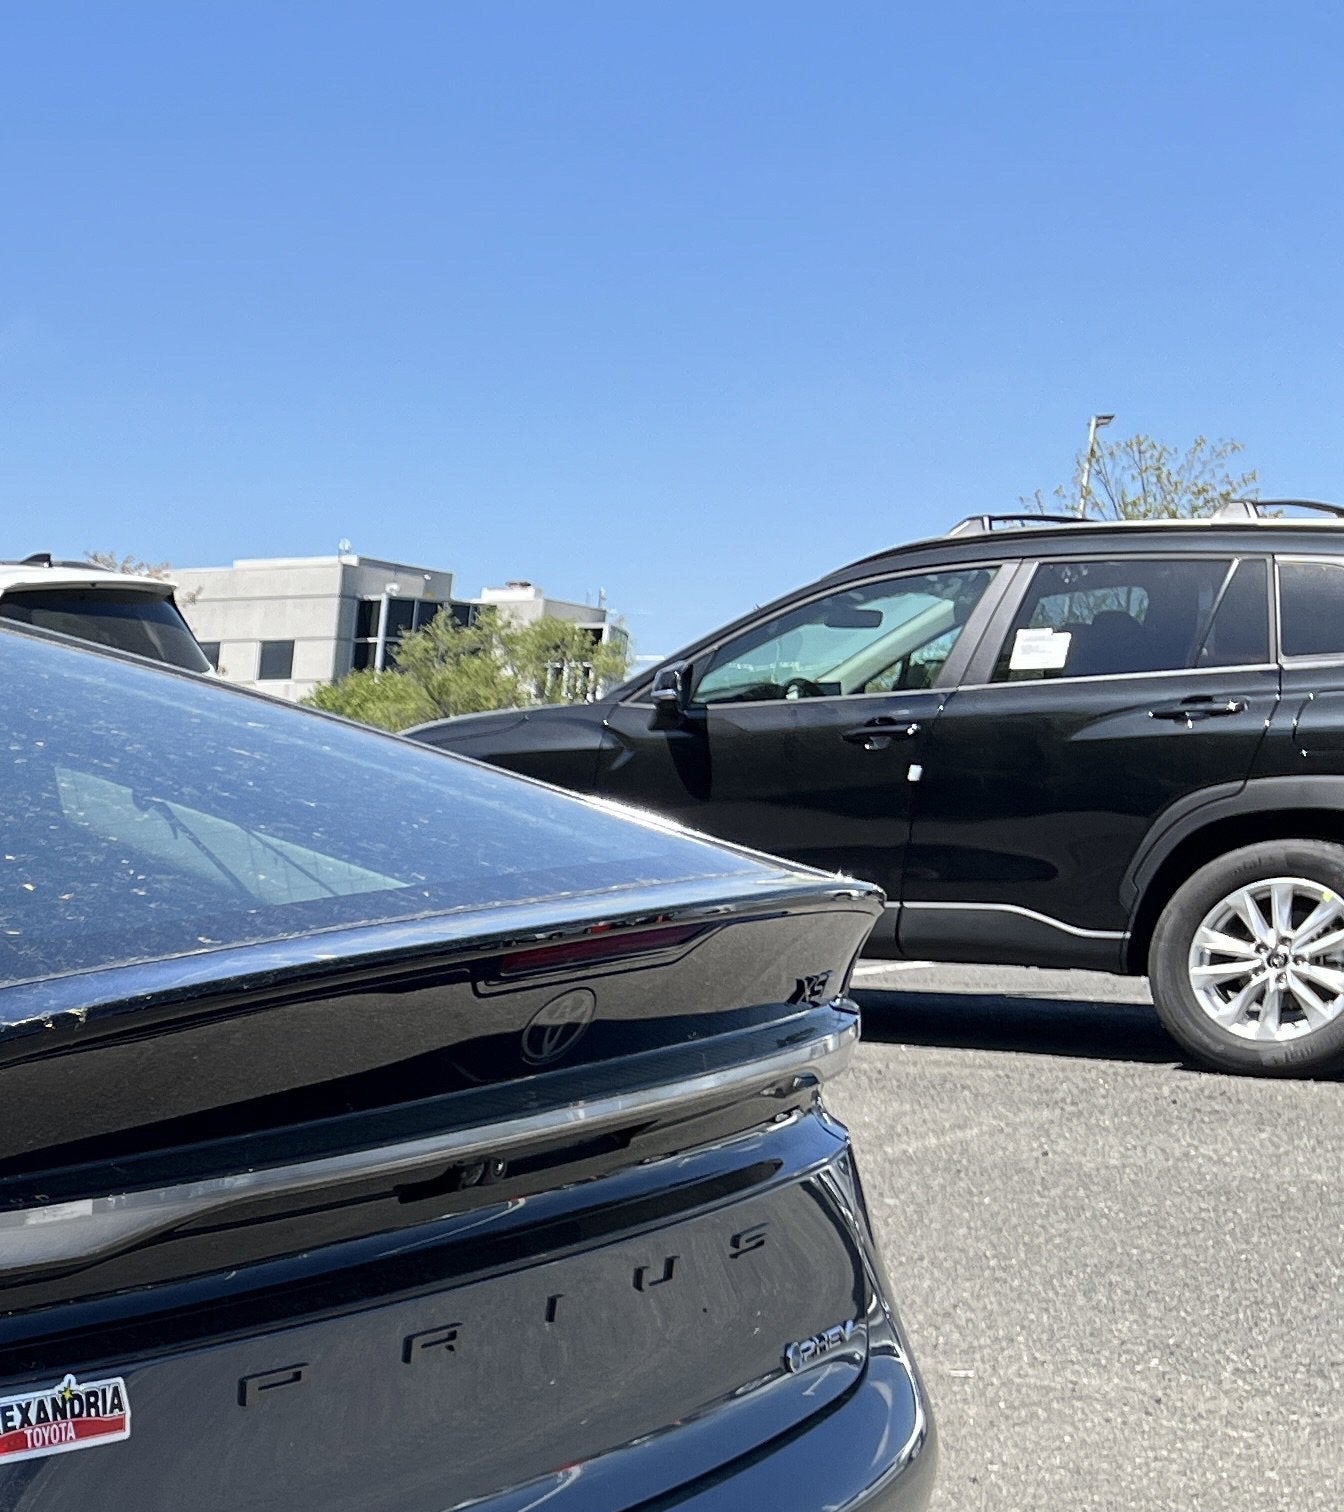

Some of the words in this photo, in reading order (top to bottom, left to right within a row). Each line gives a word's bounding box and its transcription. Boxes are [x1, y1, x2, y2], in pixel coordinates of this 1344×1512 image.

[237, 1222, 770, 1407] PRIUS
[799, 1319, 854, 1362] PHEV
[24, 1421, 77, 1450] TOYOTA
